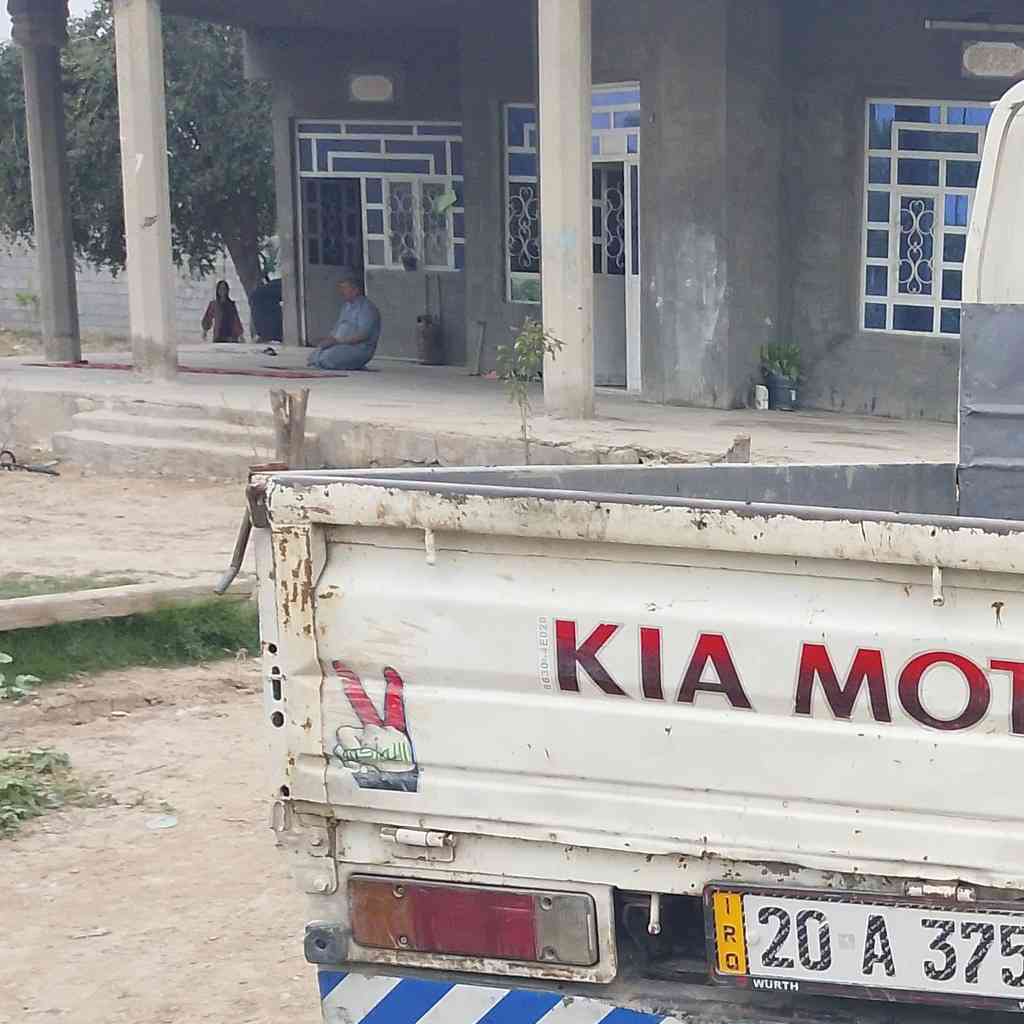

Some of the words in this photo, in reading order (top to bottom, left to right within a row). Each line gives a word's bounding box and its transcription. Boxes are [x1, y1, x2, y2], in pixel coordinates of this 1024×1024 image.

[554, 618, 754, 711] KIA
[723, 896, 740, 970] IRQ
[757, 906, 832, 971] 20
[862, 914, 896, 977] A
